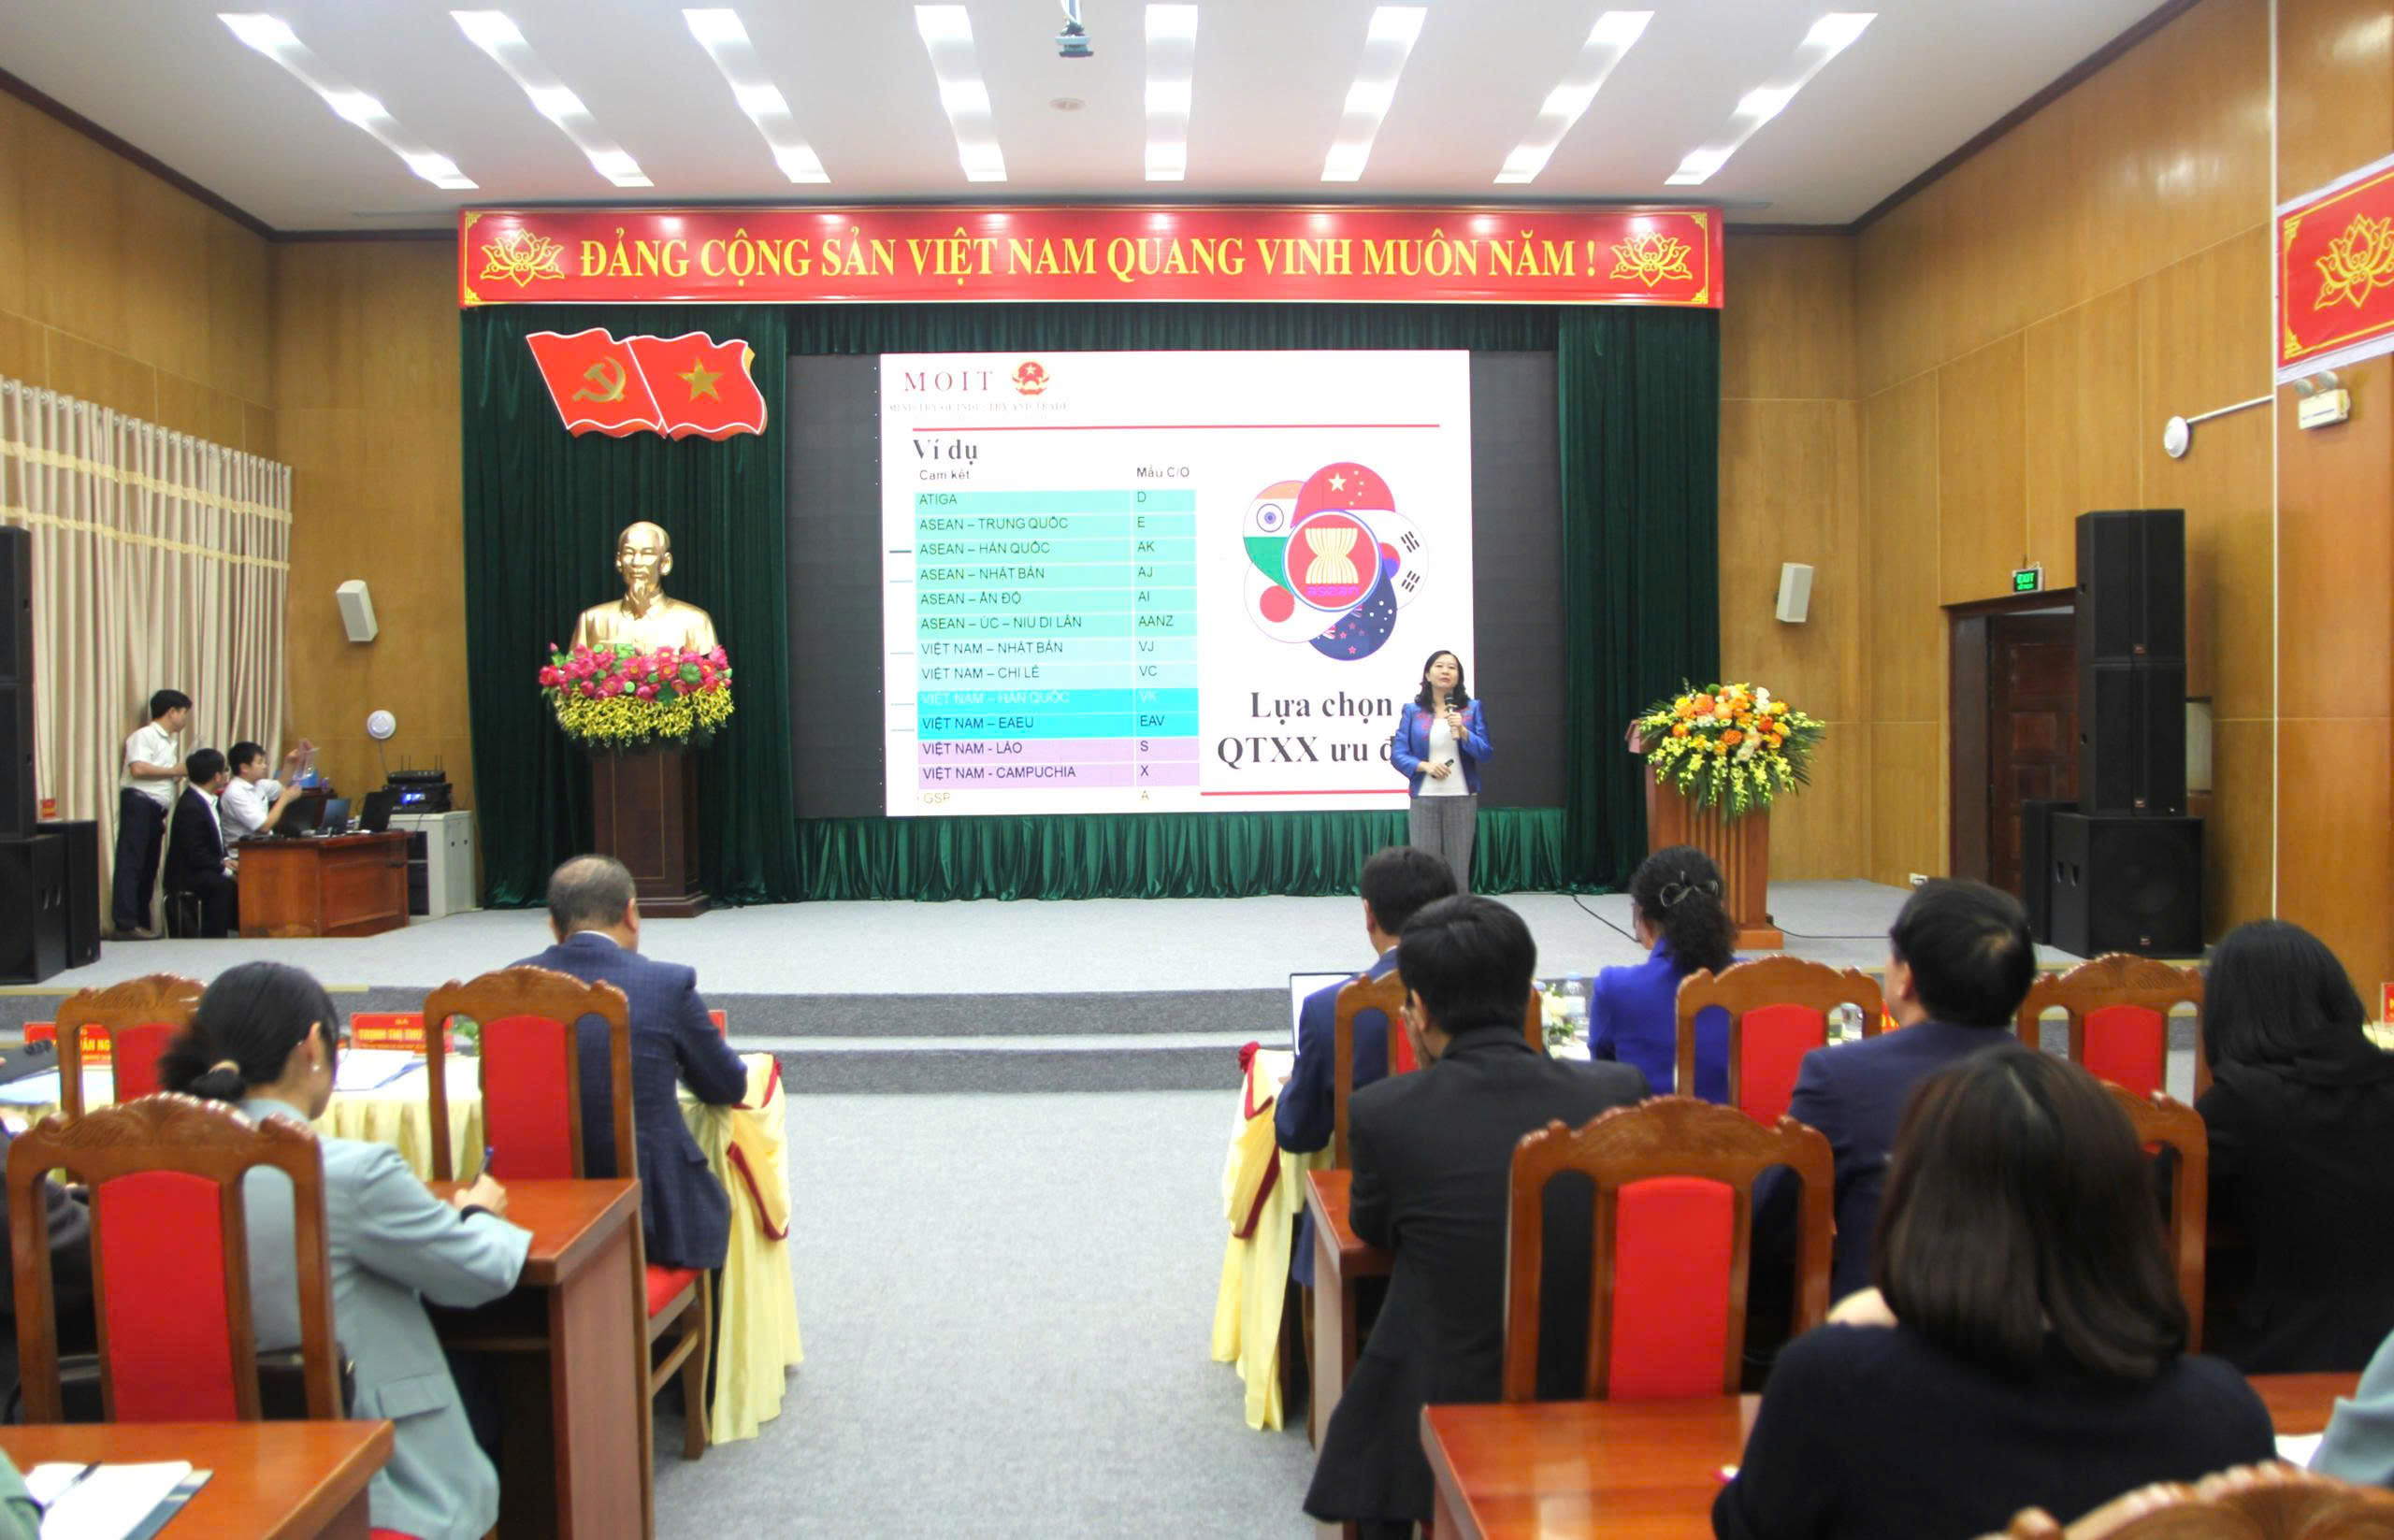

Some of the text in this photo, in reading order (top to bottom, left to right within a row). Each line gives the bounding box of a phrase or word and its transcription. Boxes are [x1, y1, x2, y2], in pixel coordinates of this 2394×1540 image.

[580, 227, 690, 278] ĐẢNG
[700, 229, 811, 287] CỘNG
[822, 226, 896, 278] SẢN
[908, 227, 999, 286] VIỆT
[1008, 237, 1097, 276] NAM
[1107, 236, 1247, 283] QUANG
[1256, 237, 1352, 277] VINH
[1363, 227, 1478, 278] MUÔN
[1488, 228, 1577, 278] NĂM
[913, 439, 978, 466] Ví dụ
[919, 469, 947, 481] Cam
[1167, 467, 1190, 478] C/O
[919, 494, 958, 505] ATIGA
[1137, 491, 1147, 503] D
[920, 519, 964, 530] ASEAN
[978, 518, 1026, 530] TRUNG
[1137, 516, 1146, 528] E
[920, 543, 964, 554] ASEAN
[1137, 540, 1155, 553] AK
[920, 569, 964, 580] ASEAN
[1138, 566, 1153, 578] AJ
[921, 594, 965, 605] ASEAN
[1138, 591, 1150, 602] AI
[921, 618, 965, 629] ASEAN
[1014, 617, 1036, 627] NIU
[1040, 617, 1052, 627] DI
[1138, 615, 1174, 627] AANZ
[921, 642, 950, 655] VIỆT
[955, 643, 983, 655] NAM
[1139, 640, 1154, 652] VJ
[921, 667, 950, 680] VIỆT
[955, 669, 983, 679] NAM
[998, 668, 1020, 679] CHI
[1139, 666, 1158, 677] VC
[1250, 690, 1392, 726] Lựa chọn
[922, 716, 951, 730] VIỆT
[955, 717, 984, 728] NAM
[999, 716, 1034, 728] EAEU
[1140, 715, 1165, 727] EAV
[922, 741, 951, 756] VIỆT
[956, 743, 984, 754] NAM
[1140, 741, 1149, 752] S
[1217, 736, 1319, 770] QTXX
[1330, 742, 1369, 762] ưu
[923, 767, 952, 780] VIỆT
[956, 768, 985, 779] NAM
[996, 766, 1076, 778] CAMPUCHIA
[1140, 765, 1149, 777] X
